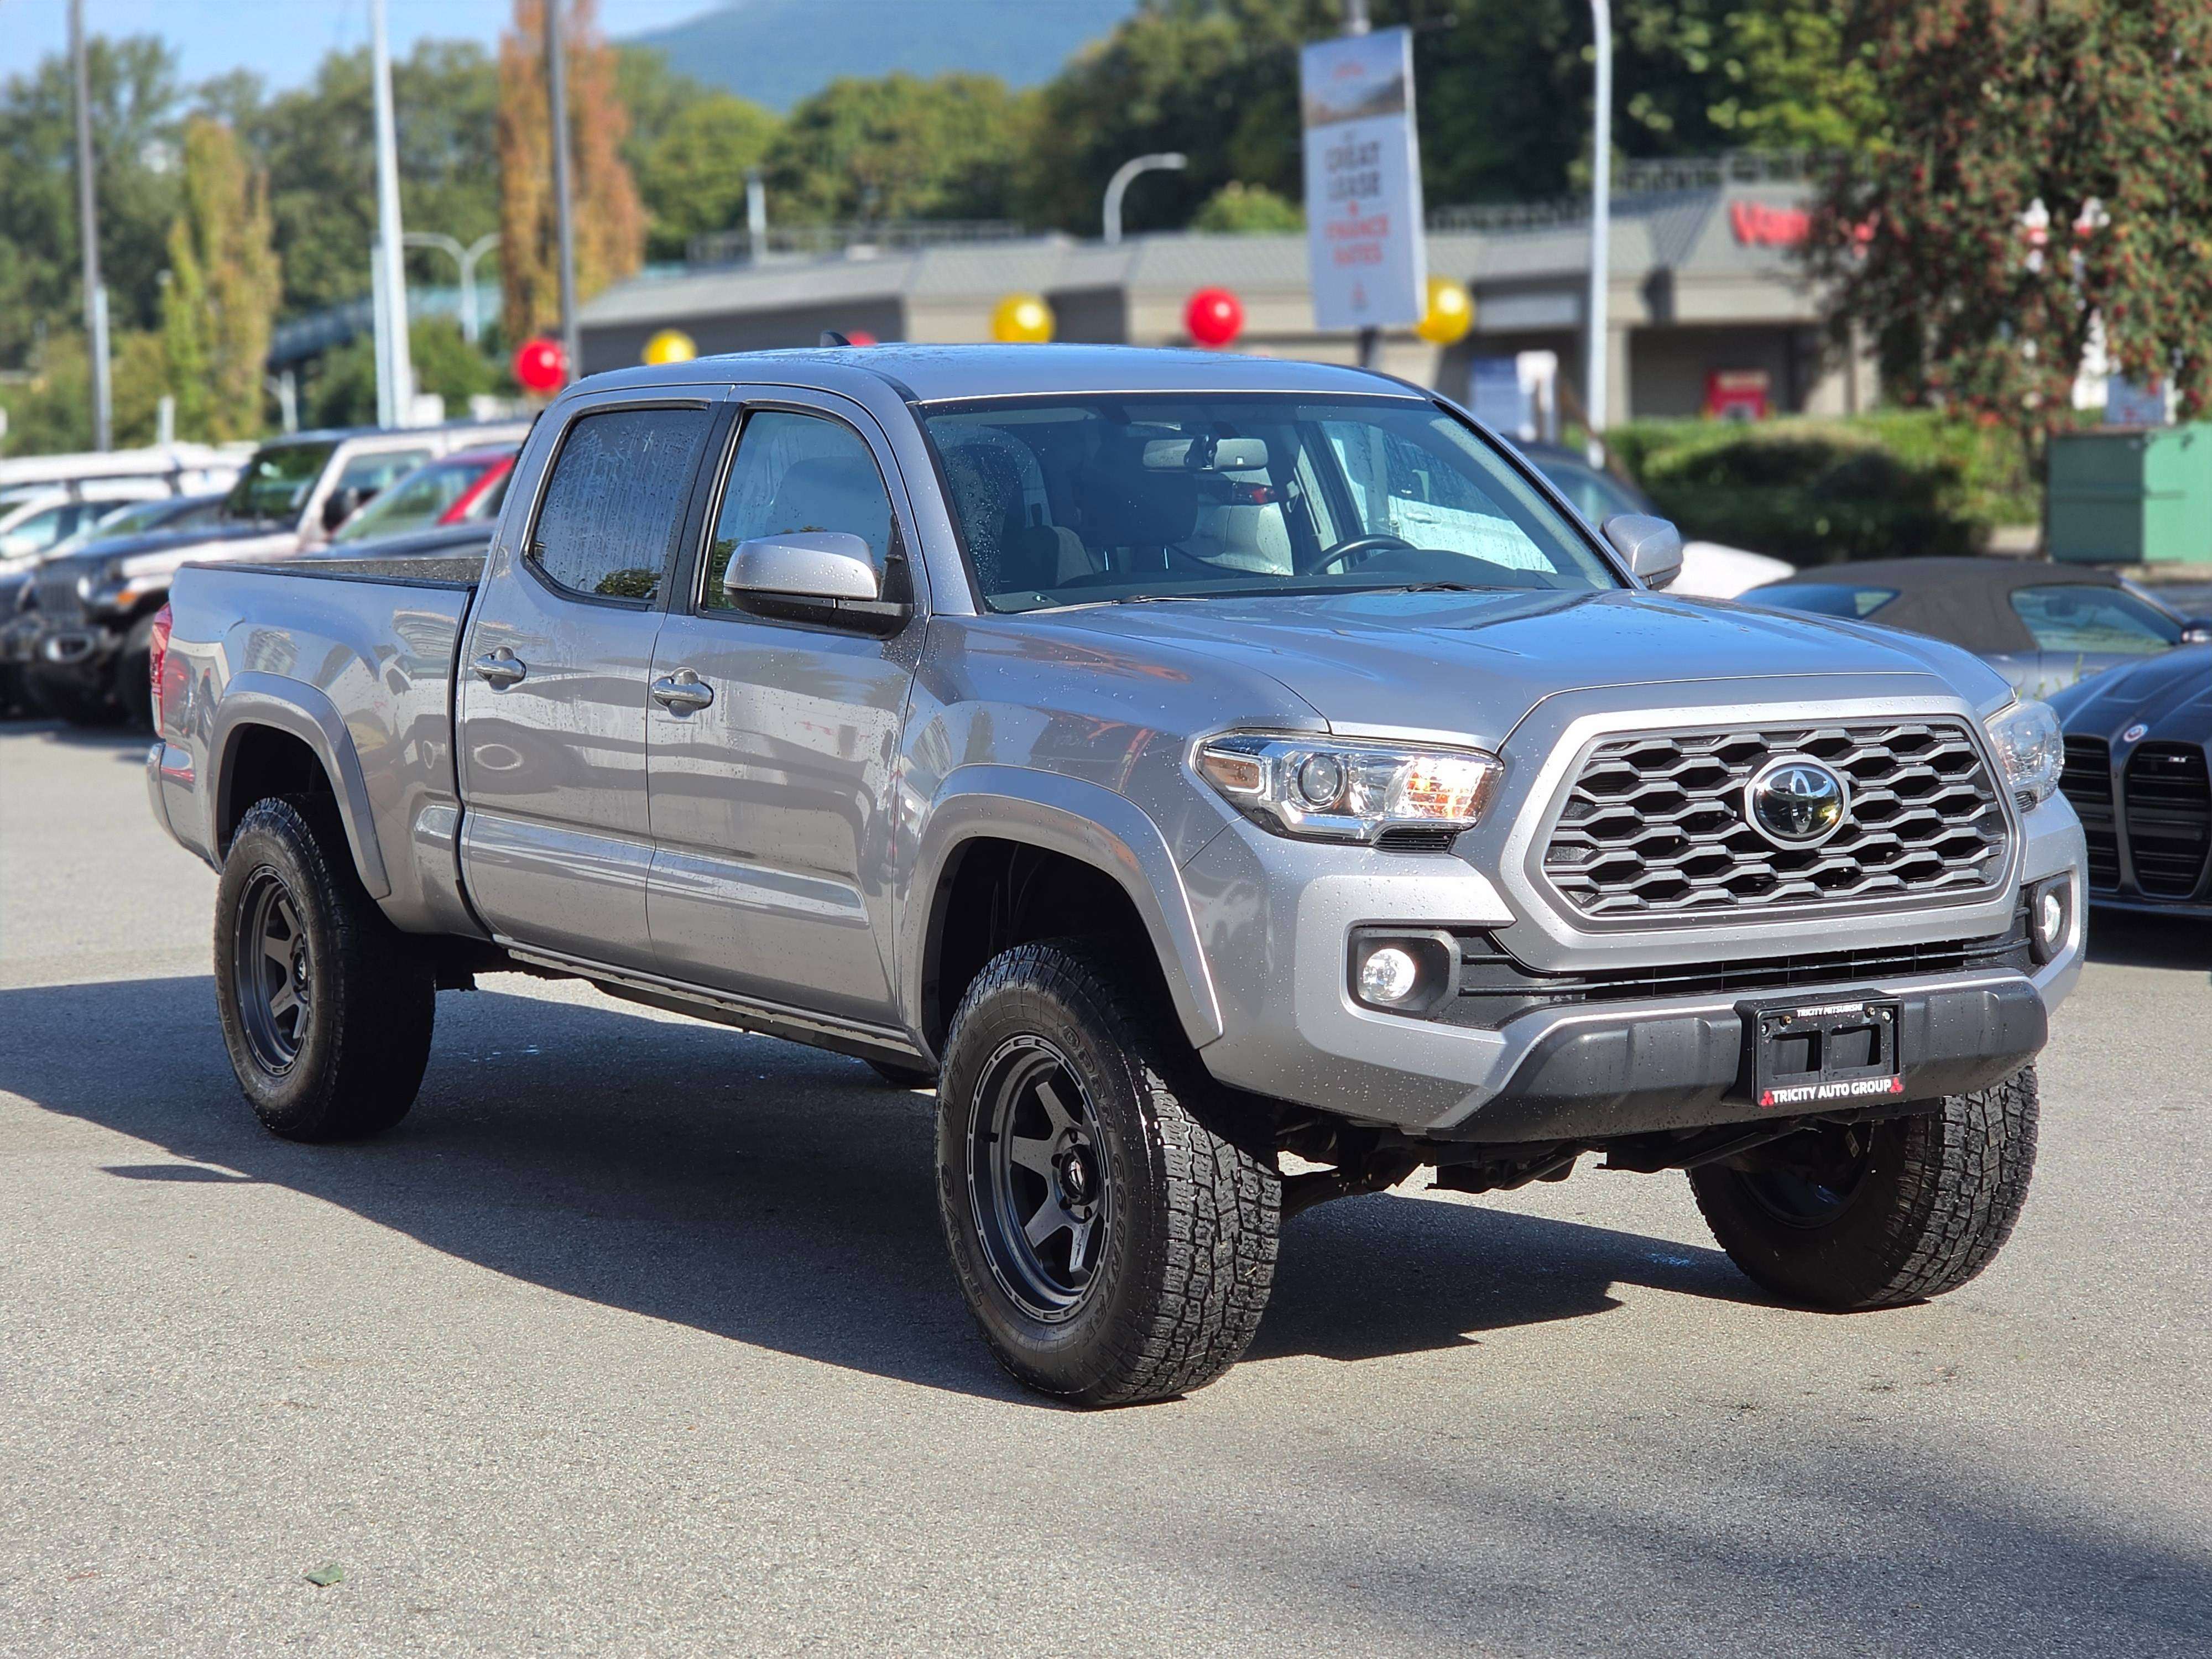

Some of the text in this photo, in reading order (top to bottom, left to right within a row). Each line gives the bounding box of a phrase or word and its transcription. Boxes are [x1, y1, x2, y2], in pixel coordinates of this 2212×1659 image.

[1797, 1007, 1823, 1017] TRICITY
[1772, 1078, 1892, 1104] TRICITY AUTO GROUP
